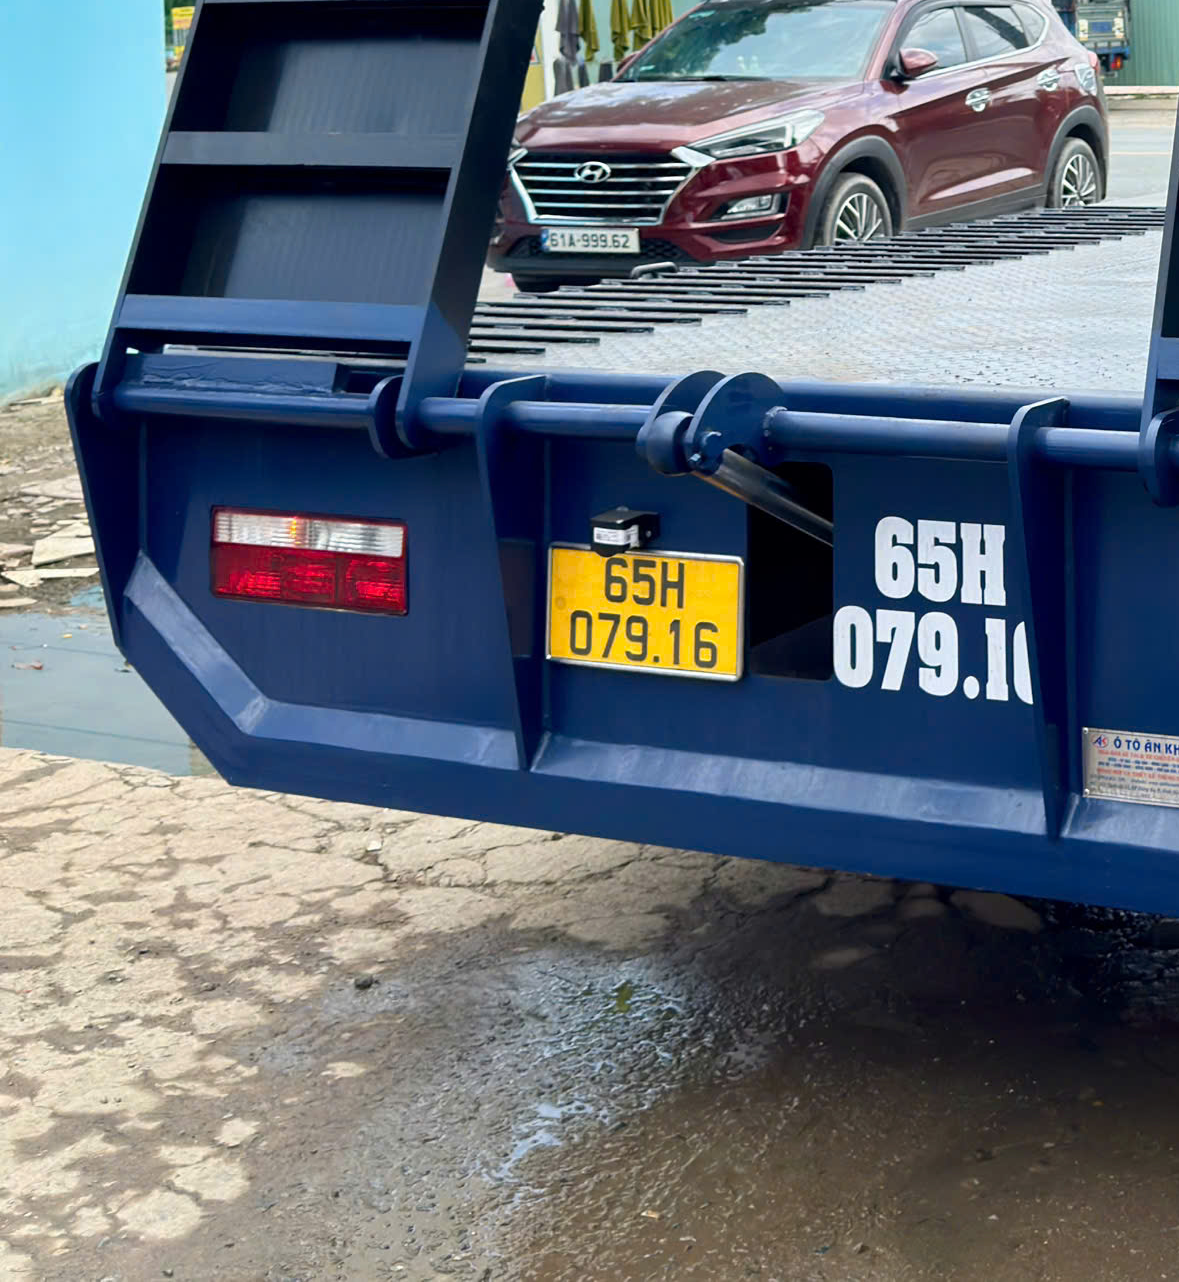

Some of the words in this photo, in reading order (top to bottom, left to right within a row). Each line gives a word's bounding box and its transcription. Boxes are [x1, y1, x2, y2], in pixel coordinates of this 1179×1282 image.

[550, 232, 630, 249] 61A-999.62
[604, 556, 685, 609] 65H
[874, 515, 1007, 606] 65H
[569, 609, 718, 668] 079.16
